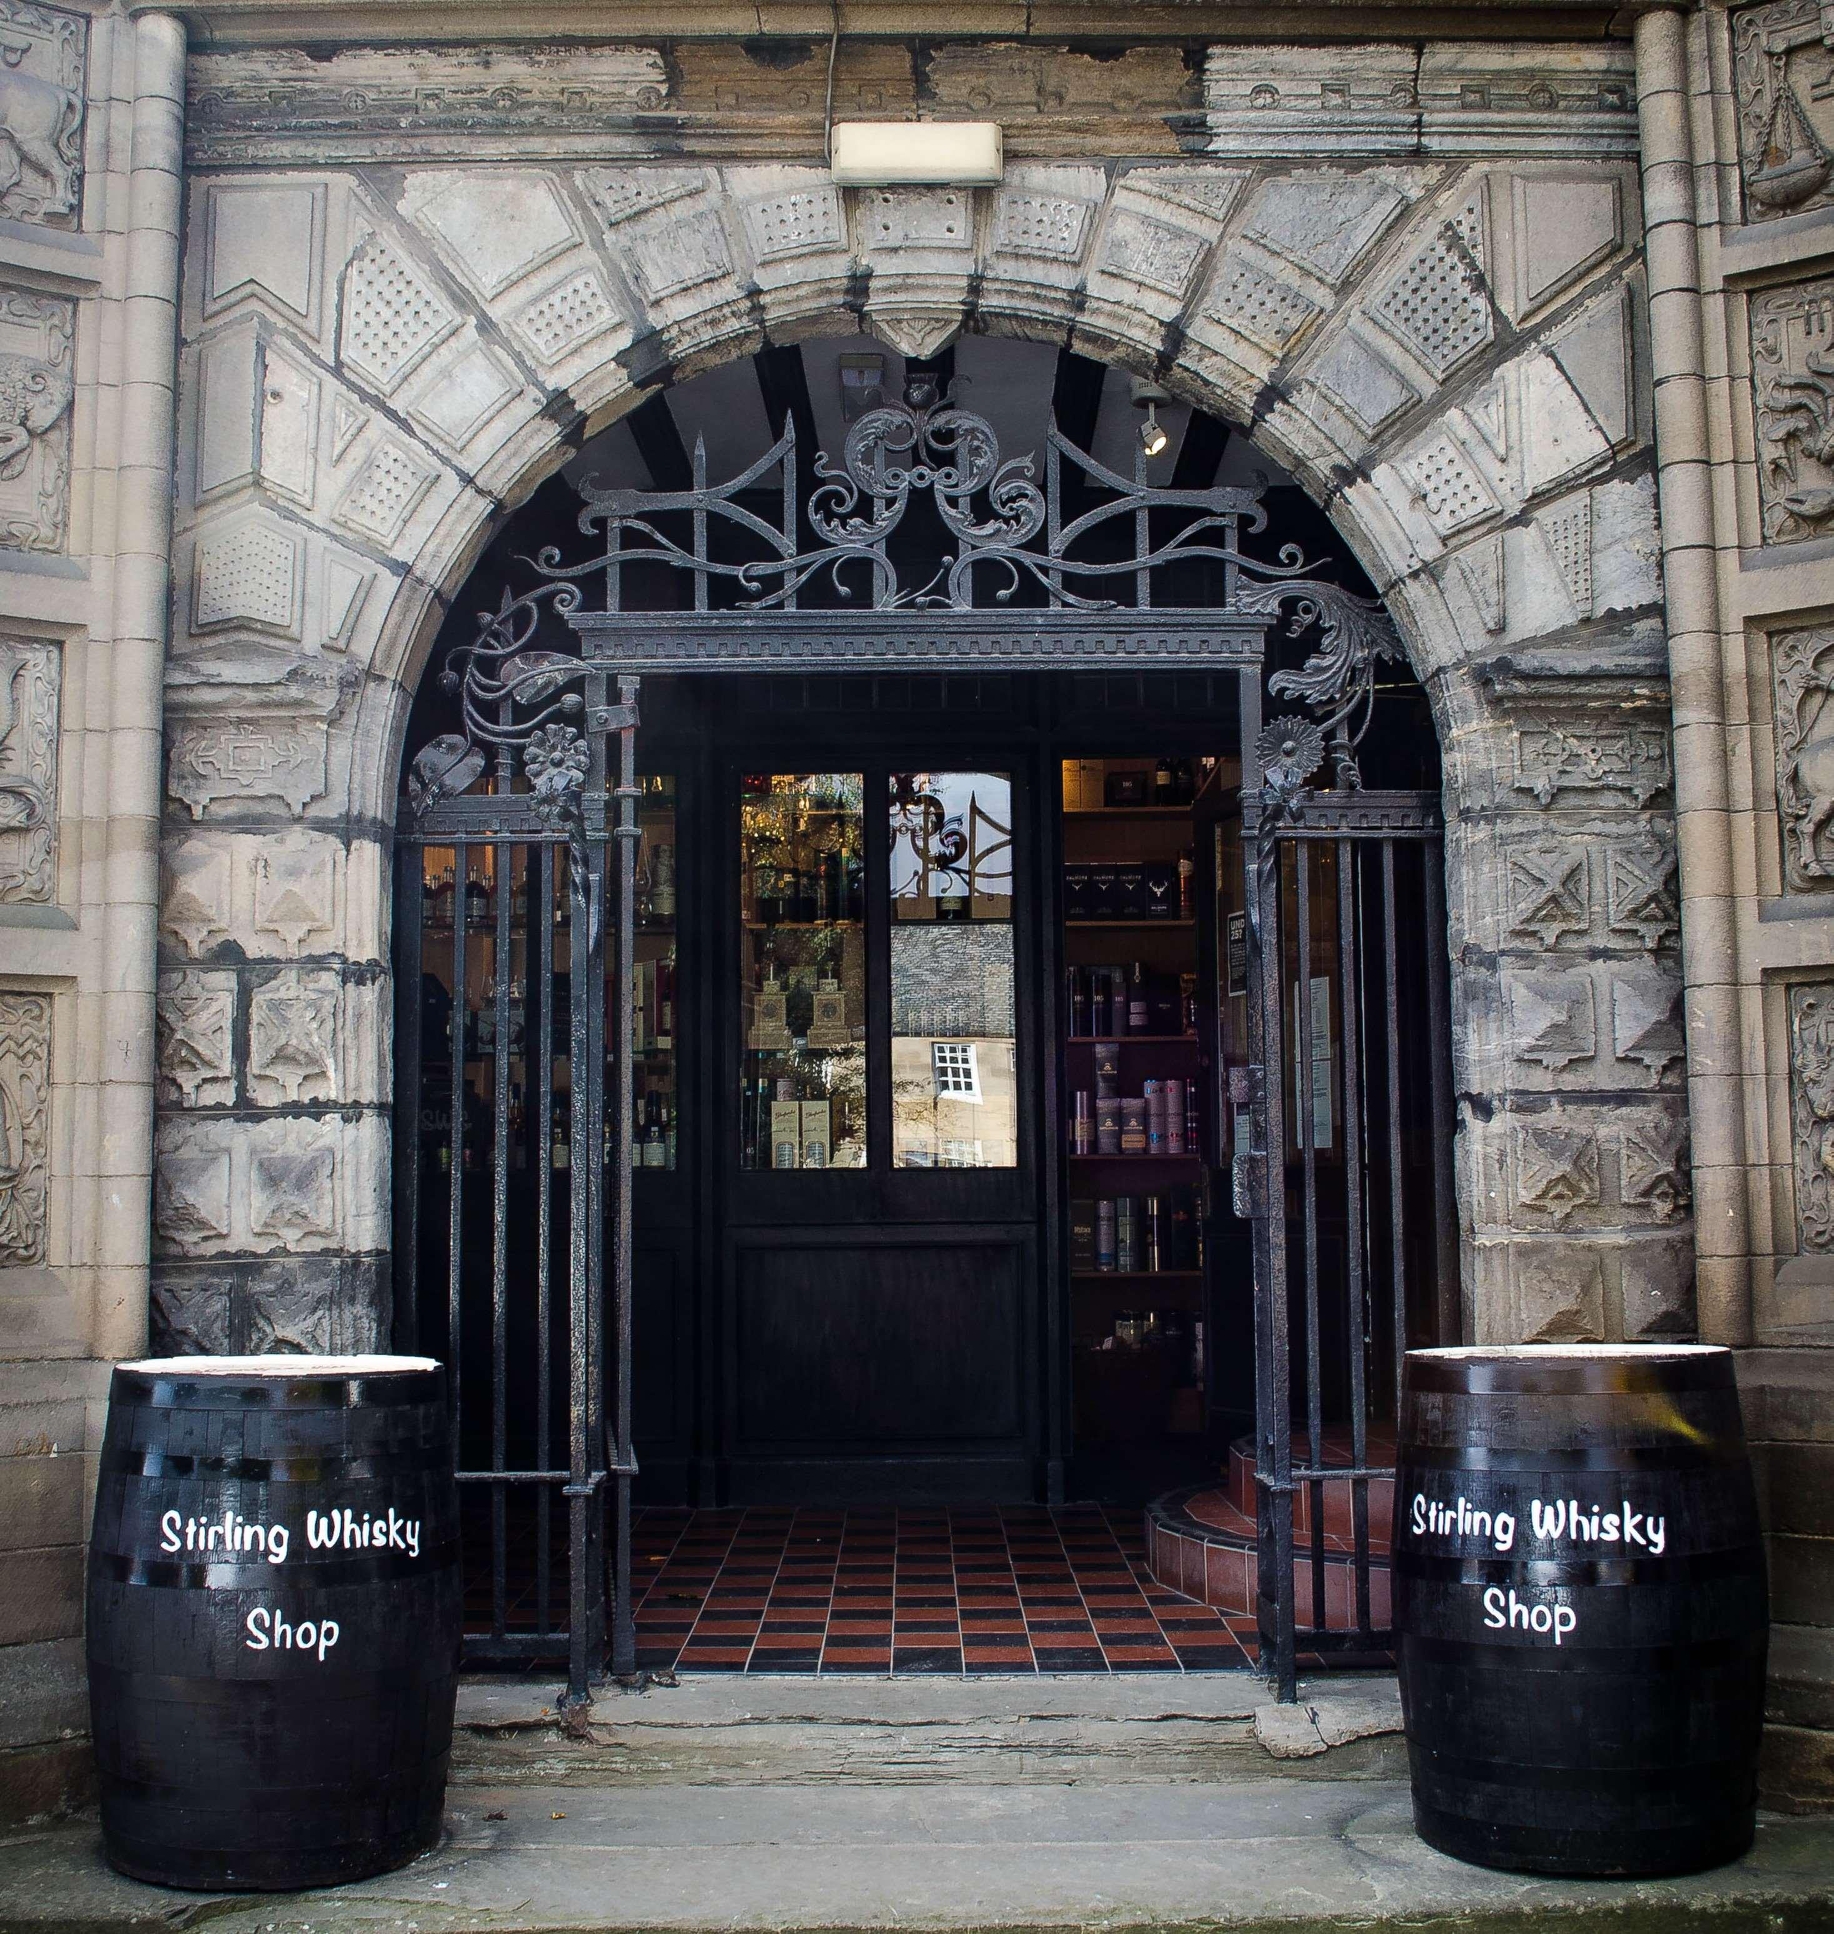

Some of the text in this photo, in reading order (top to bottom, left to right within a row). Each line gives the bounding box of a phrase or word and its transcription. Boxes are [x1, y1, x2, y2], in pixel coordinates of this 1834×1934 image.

[1230, 918, 1245, 930] UND
[1230, 930, 1243, 940] 25?
[160, 1507, 420, 1564] Stirling Whisky
[1412, 1493, 1665, 1554] Stirling Whisky
[245, 1607, 339, 1662] Shop
[1483, 1587, 1577, 1645] Shop
